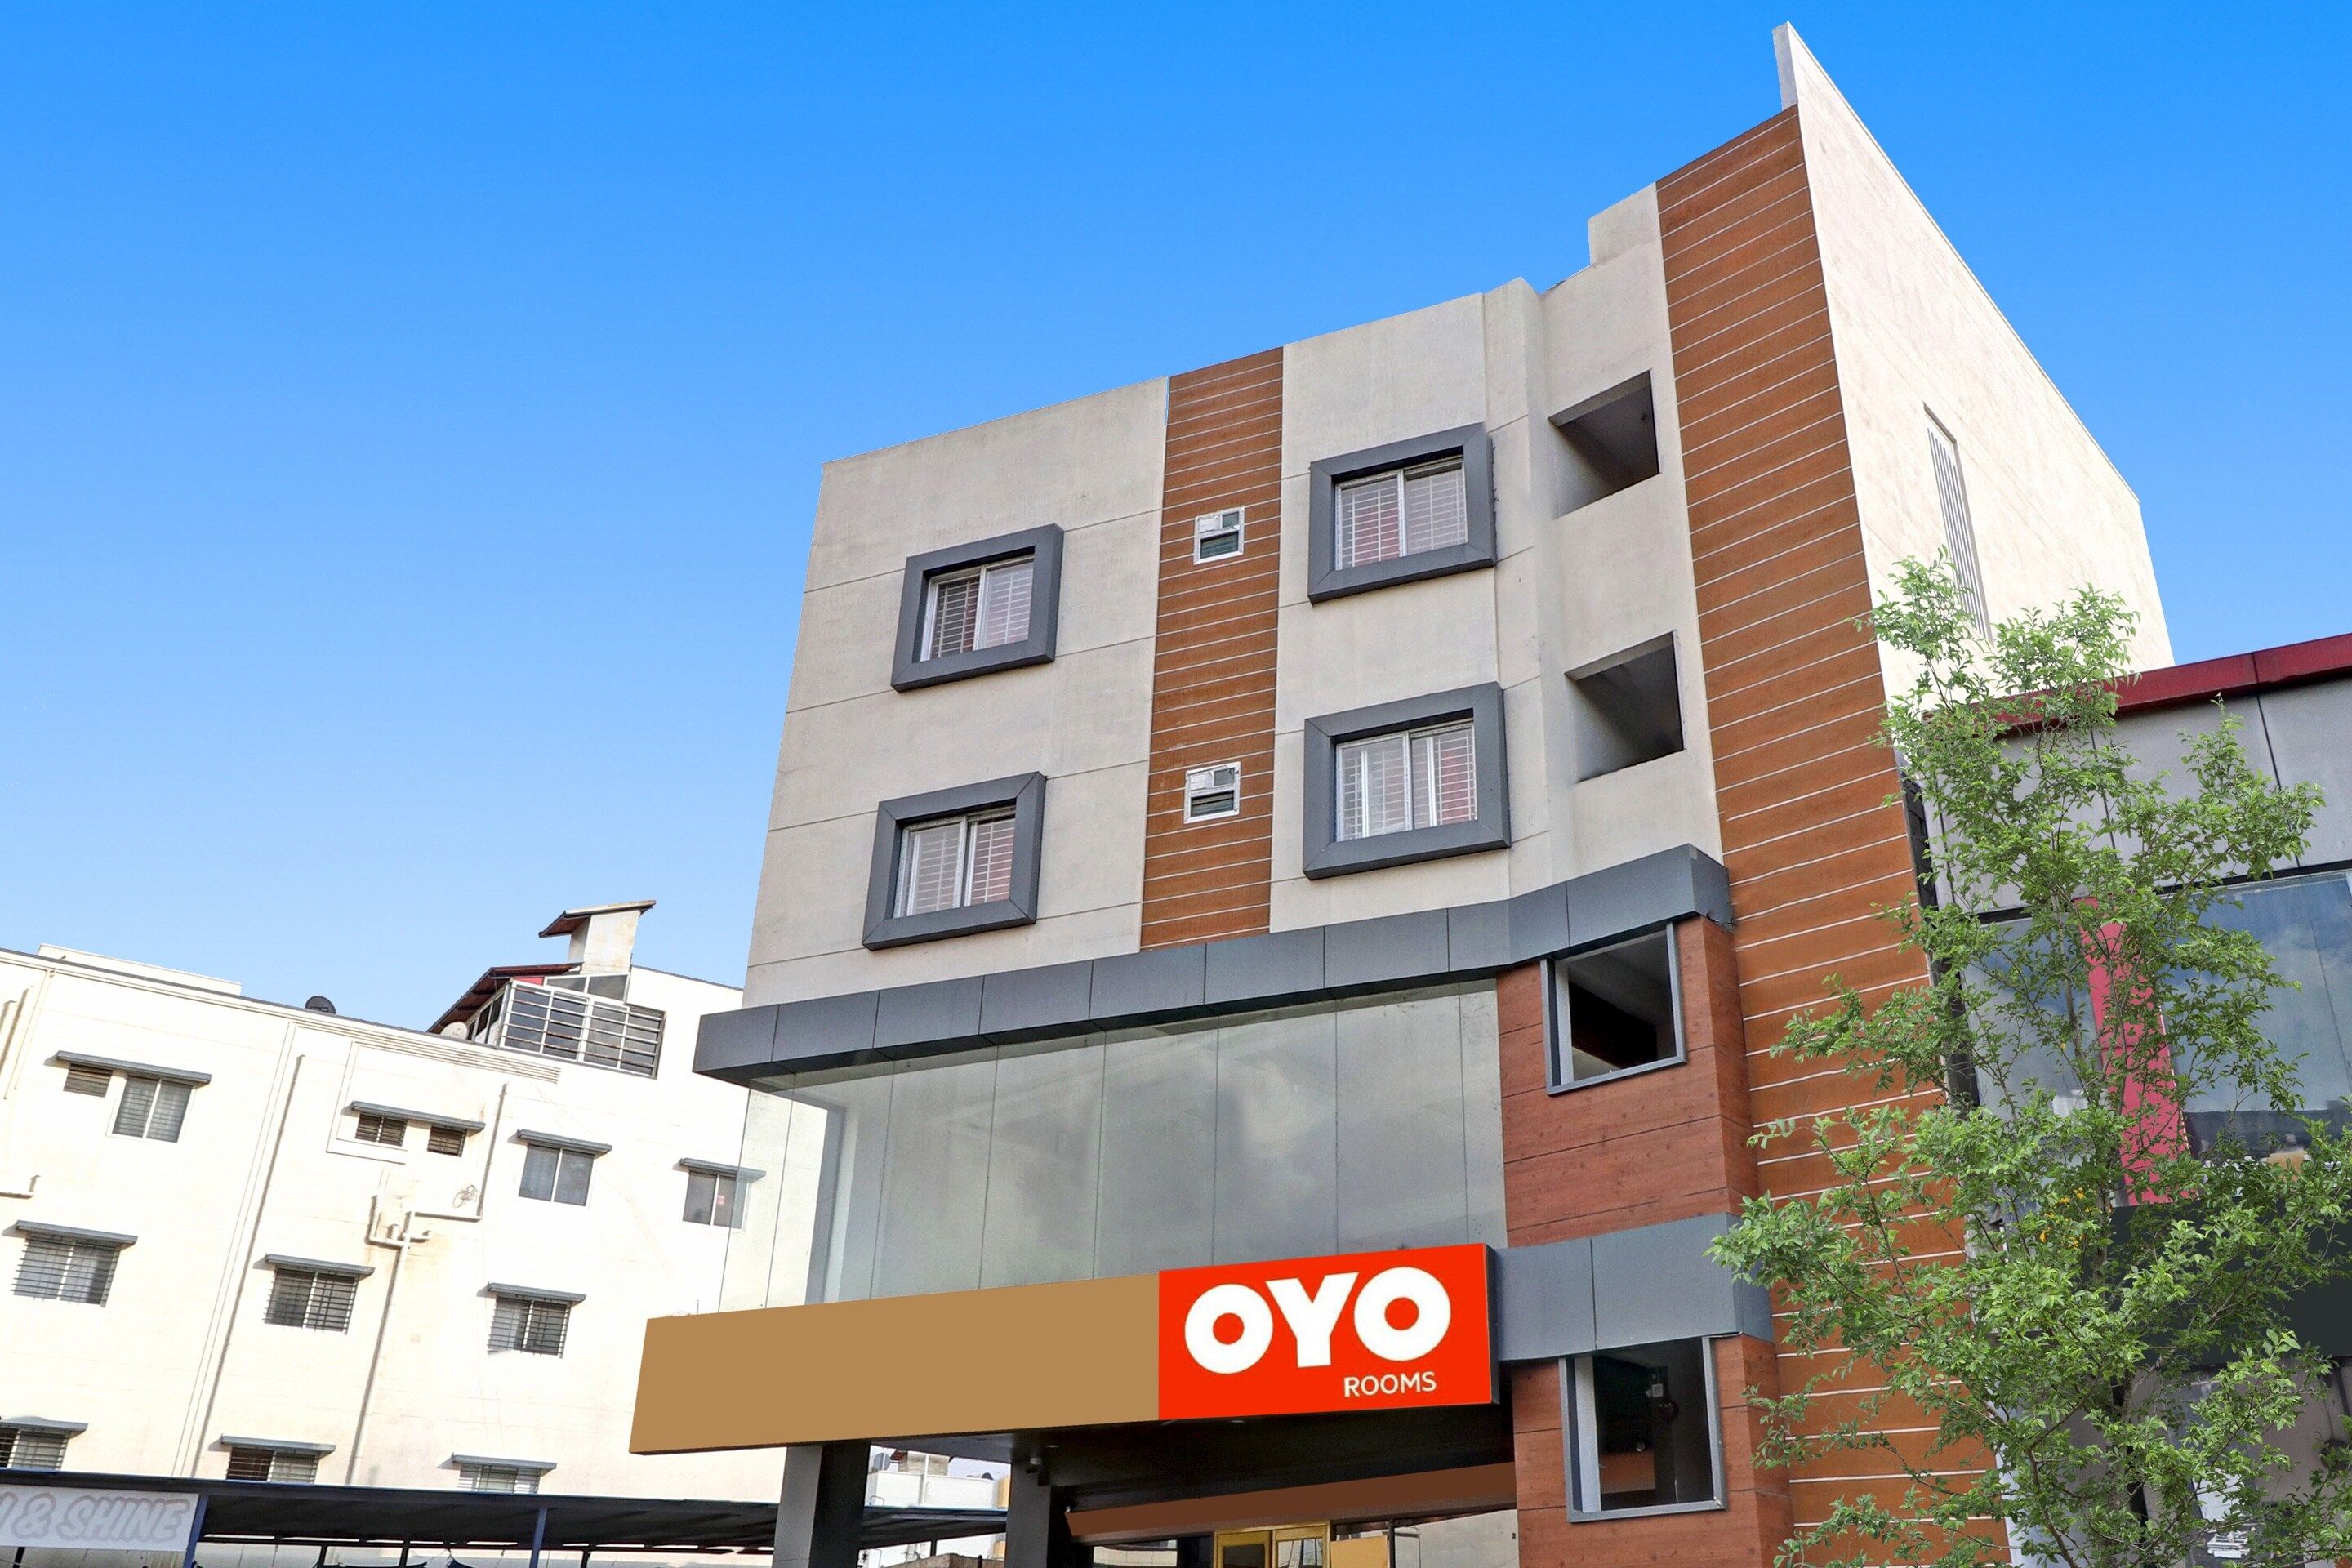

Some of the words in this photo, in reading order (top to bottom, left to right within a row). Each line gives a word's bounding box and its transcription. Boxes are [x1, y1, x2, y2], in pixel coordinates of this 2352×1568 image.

[1184, 1267, 1451, 1374] OYO
[1343, 1371, 1437, 1397] ROOMS
[11, 1493, 56, 1539] &
[55, 1495, 189, 1543] SHINE
